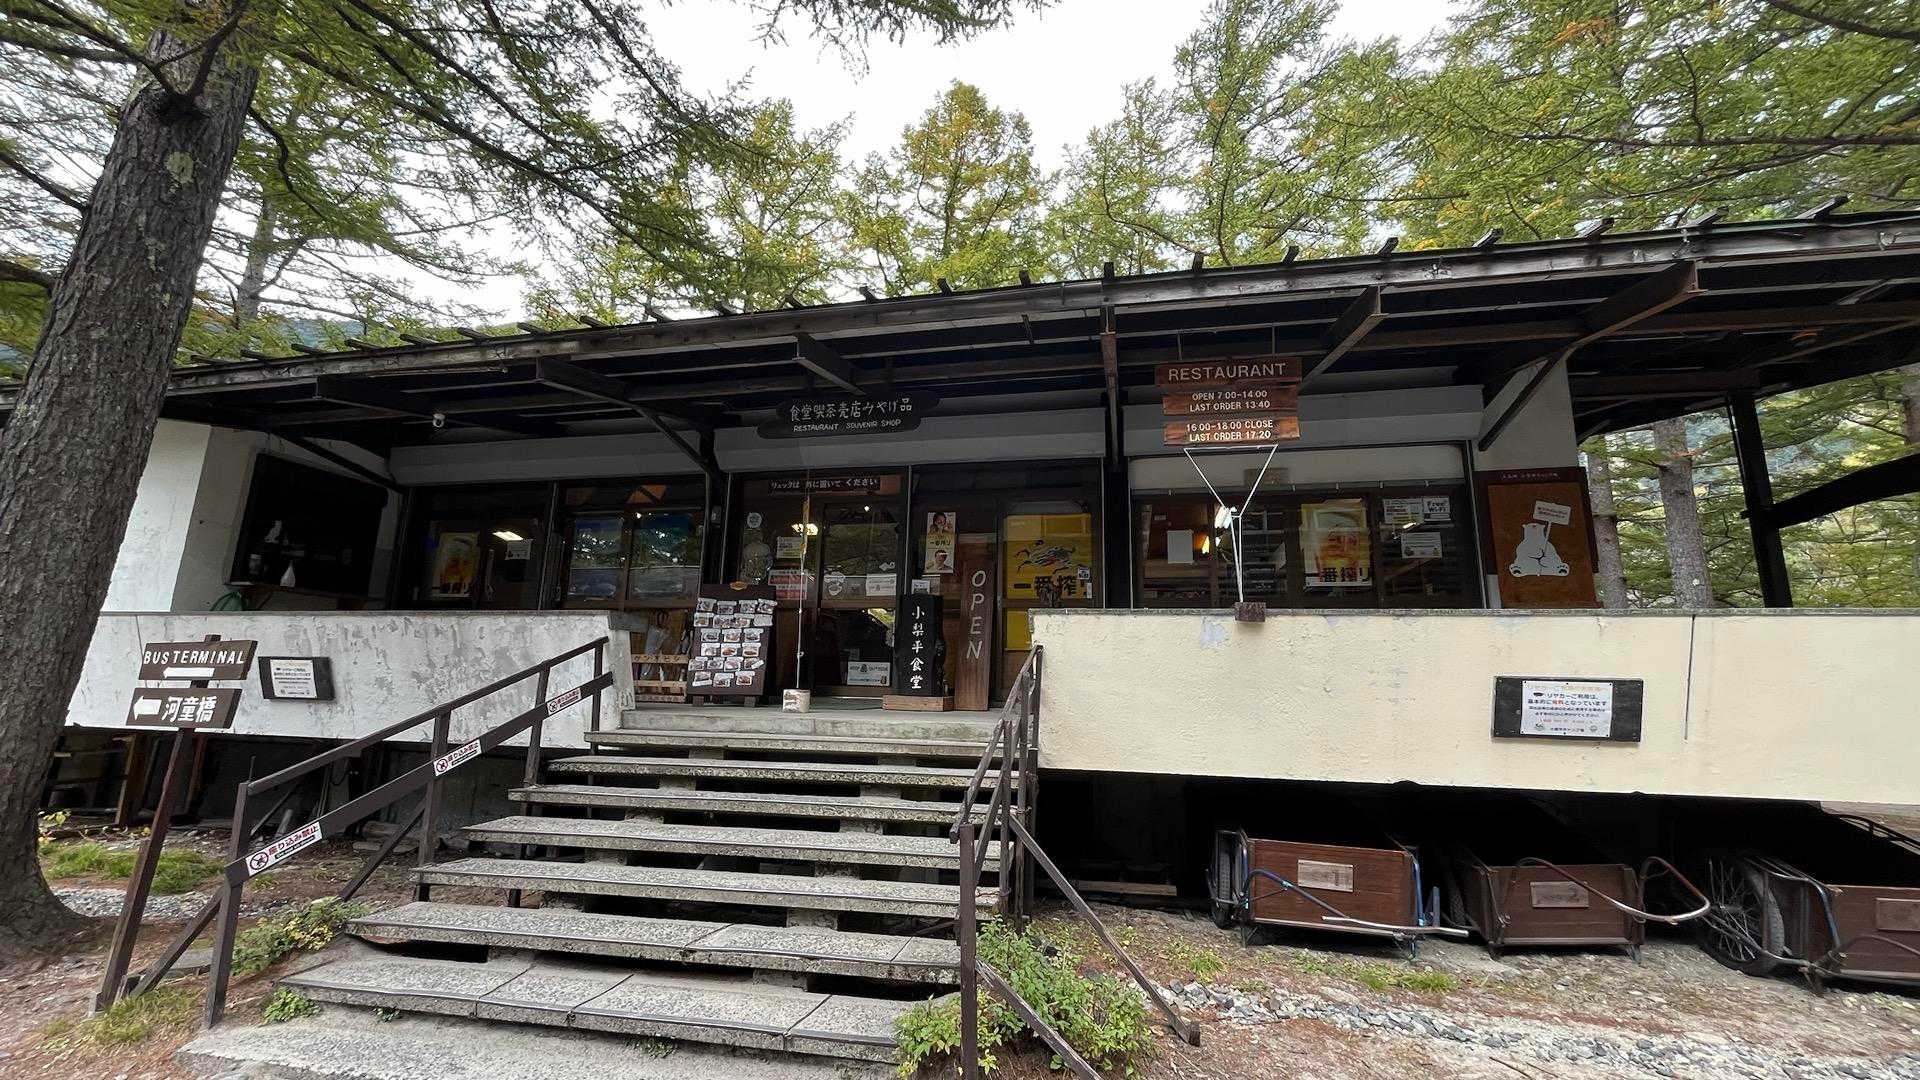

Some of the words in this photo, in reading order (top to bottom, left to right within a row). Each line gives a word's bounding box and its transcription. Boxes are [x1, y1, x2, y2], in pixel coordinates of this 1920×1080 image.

[1168, 362, 1286, 382] RESTAURANT
[1192, 392, 1215, 401] OPEN
[1189, 403, 1211, 413] LAST
[1213, 402, 1242, 411] ORDER
[1245, 400, 1271, 409] 13:40
[793, 422, 839, 433] RESTAURANT
[846, 420, 878, 430] SOUVENIR
[881, 419, 902, 428] SHOP
[1244, 419, 1274, 429] CLOSE
[1189, 432, 1211, 442] LAST
[1213, 431, 1242, 441] ORDER
[966, 569, 987, 660] OPEN
[909, 605, 925, 690] 小梨平食堂
[143, 650, 169, 665] BUS
[172, 650, 246, 665] TERMINAL
[161, 695, 218, 723] 河童橋
